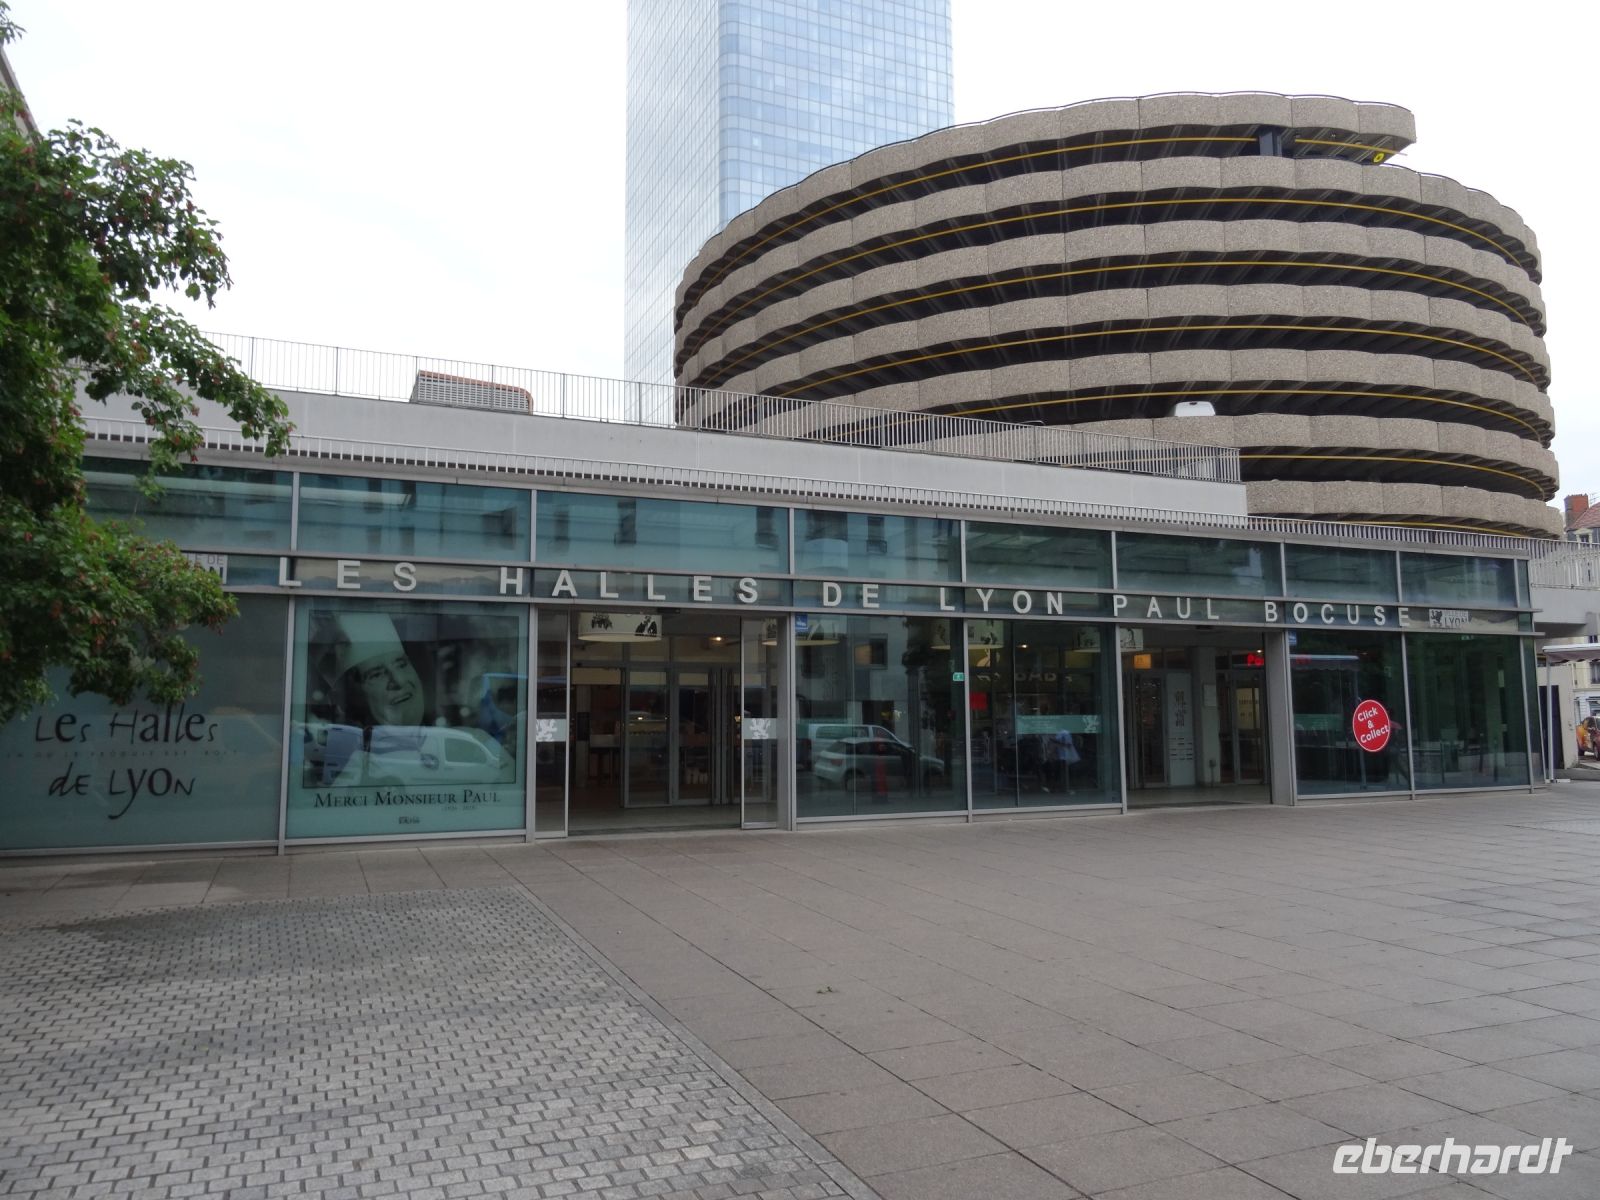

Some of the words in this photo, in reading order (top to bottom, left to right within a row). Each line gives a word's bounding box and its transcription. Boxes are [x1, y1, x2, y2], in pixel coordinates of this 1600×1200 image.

[278, 556, 417, 591] LES
[500, 567, 758, 603] HALLES
[822, 582, 880, 609] DE
[939, 587, 1063, 615] LYON
[1113, 594, 1219, 620] PAUL
[1264, 601, 1411, 627] BOCUSE
[35, 713, 91, 742] Les
[109, 702, 218, 744] Halles
[1357, 706, 1379, 722] Click
[1367, 719, 1375, 729] &
[1360, 724, 1390, 744] Collect
